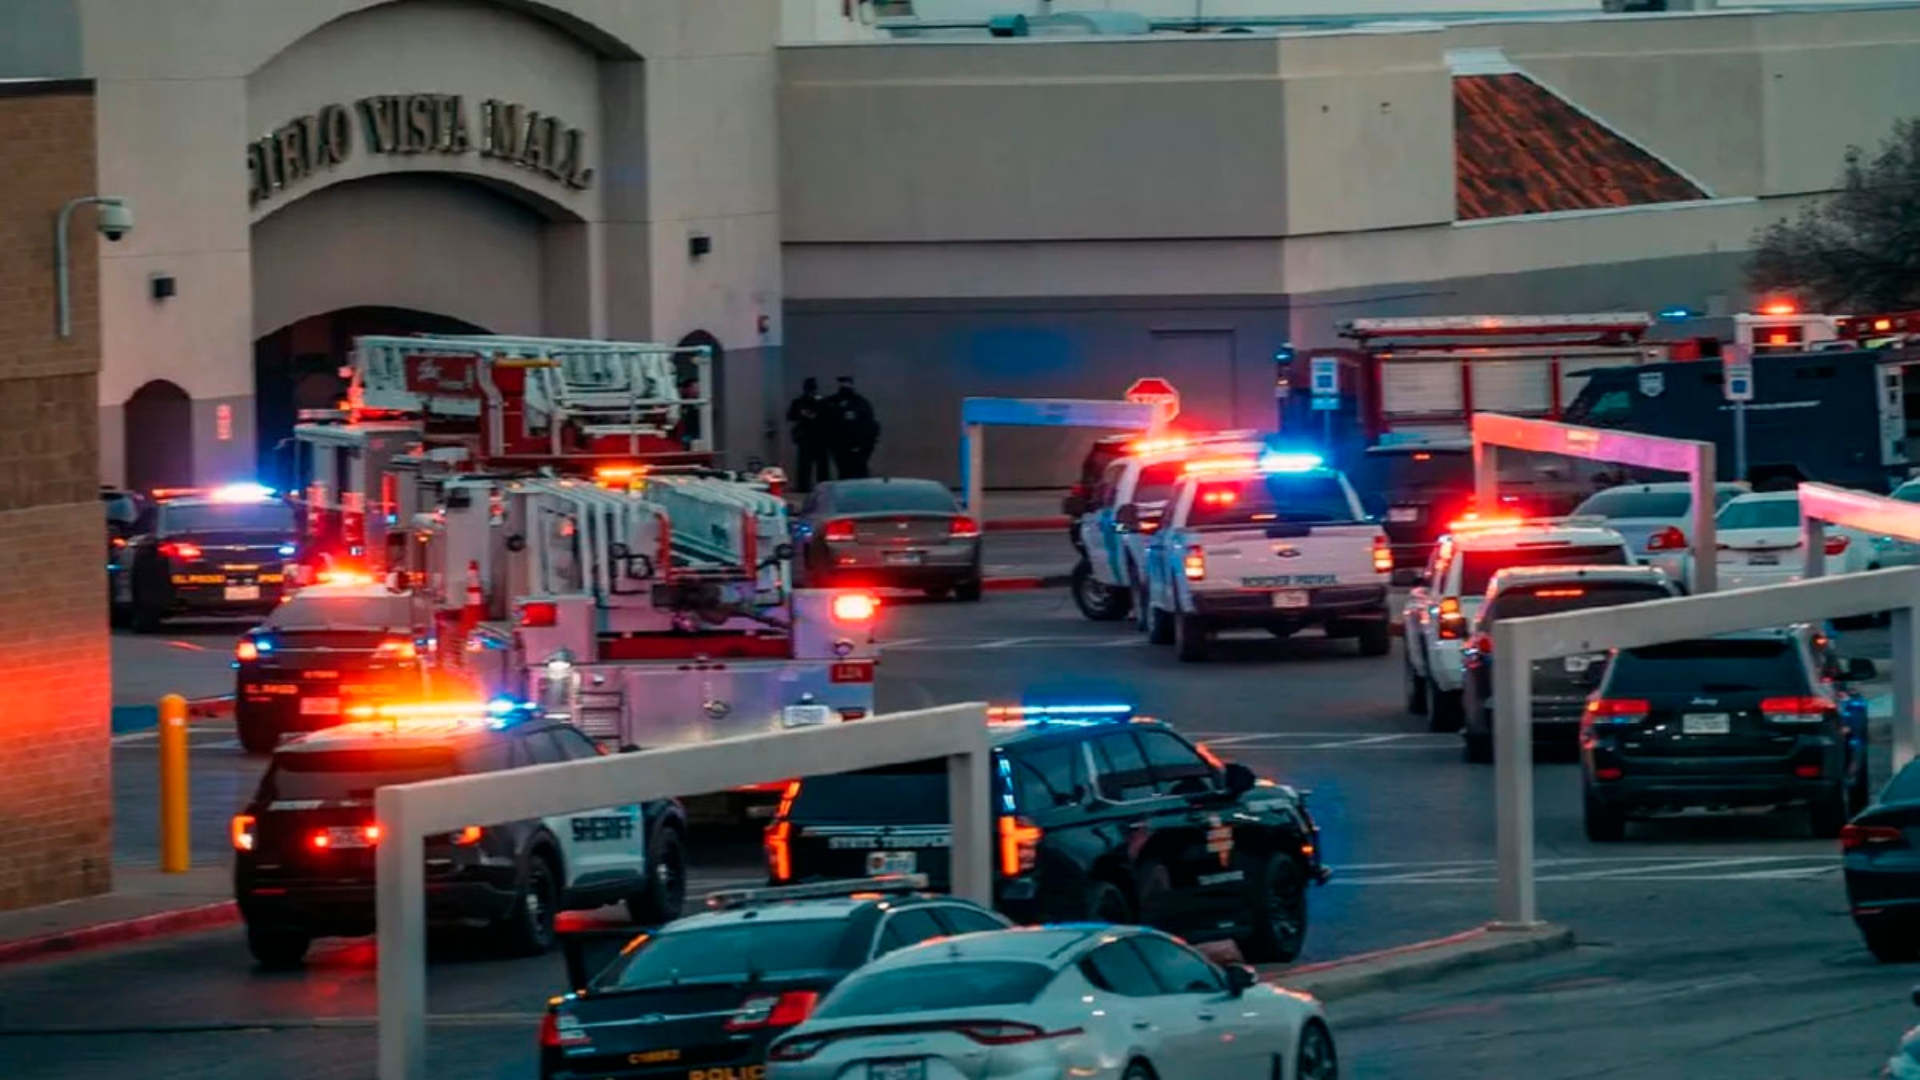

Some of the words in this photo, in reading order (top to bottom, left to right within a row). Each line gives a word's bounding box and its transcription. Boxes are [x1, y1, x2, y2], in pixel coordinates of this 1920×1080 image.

[354, 93, 470, 156] VISTA
[479, 98, 594, 191] MALL
[571, 815, 634, 842] SHERIFF
[688, 1064, 766, 1080] POLIC
